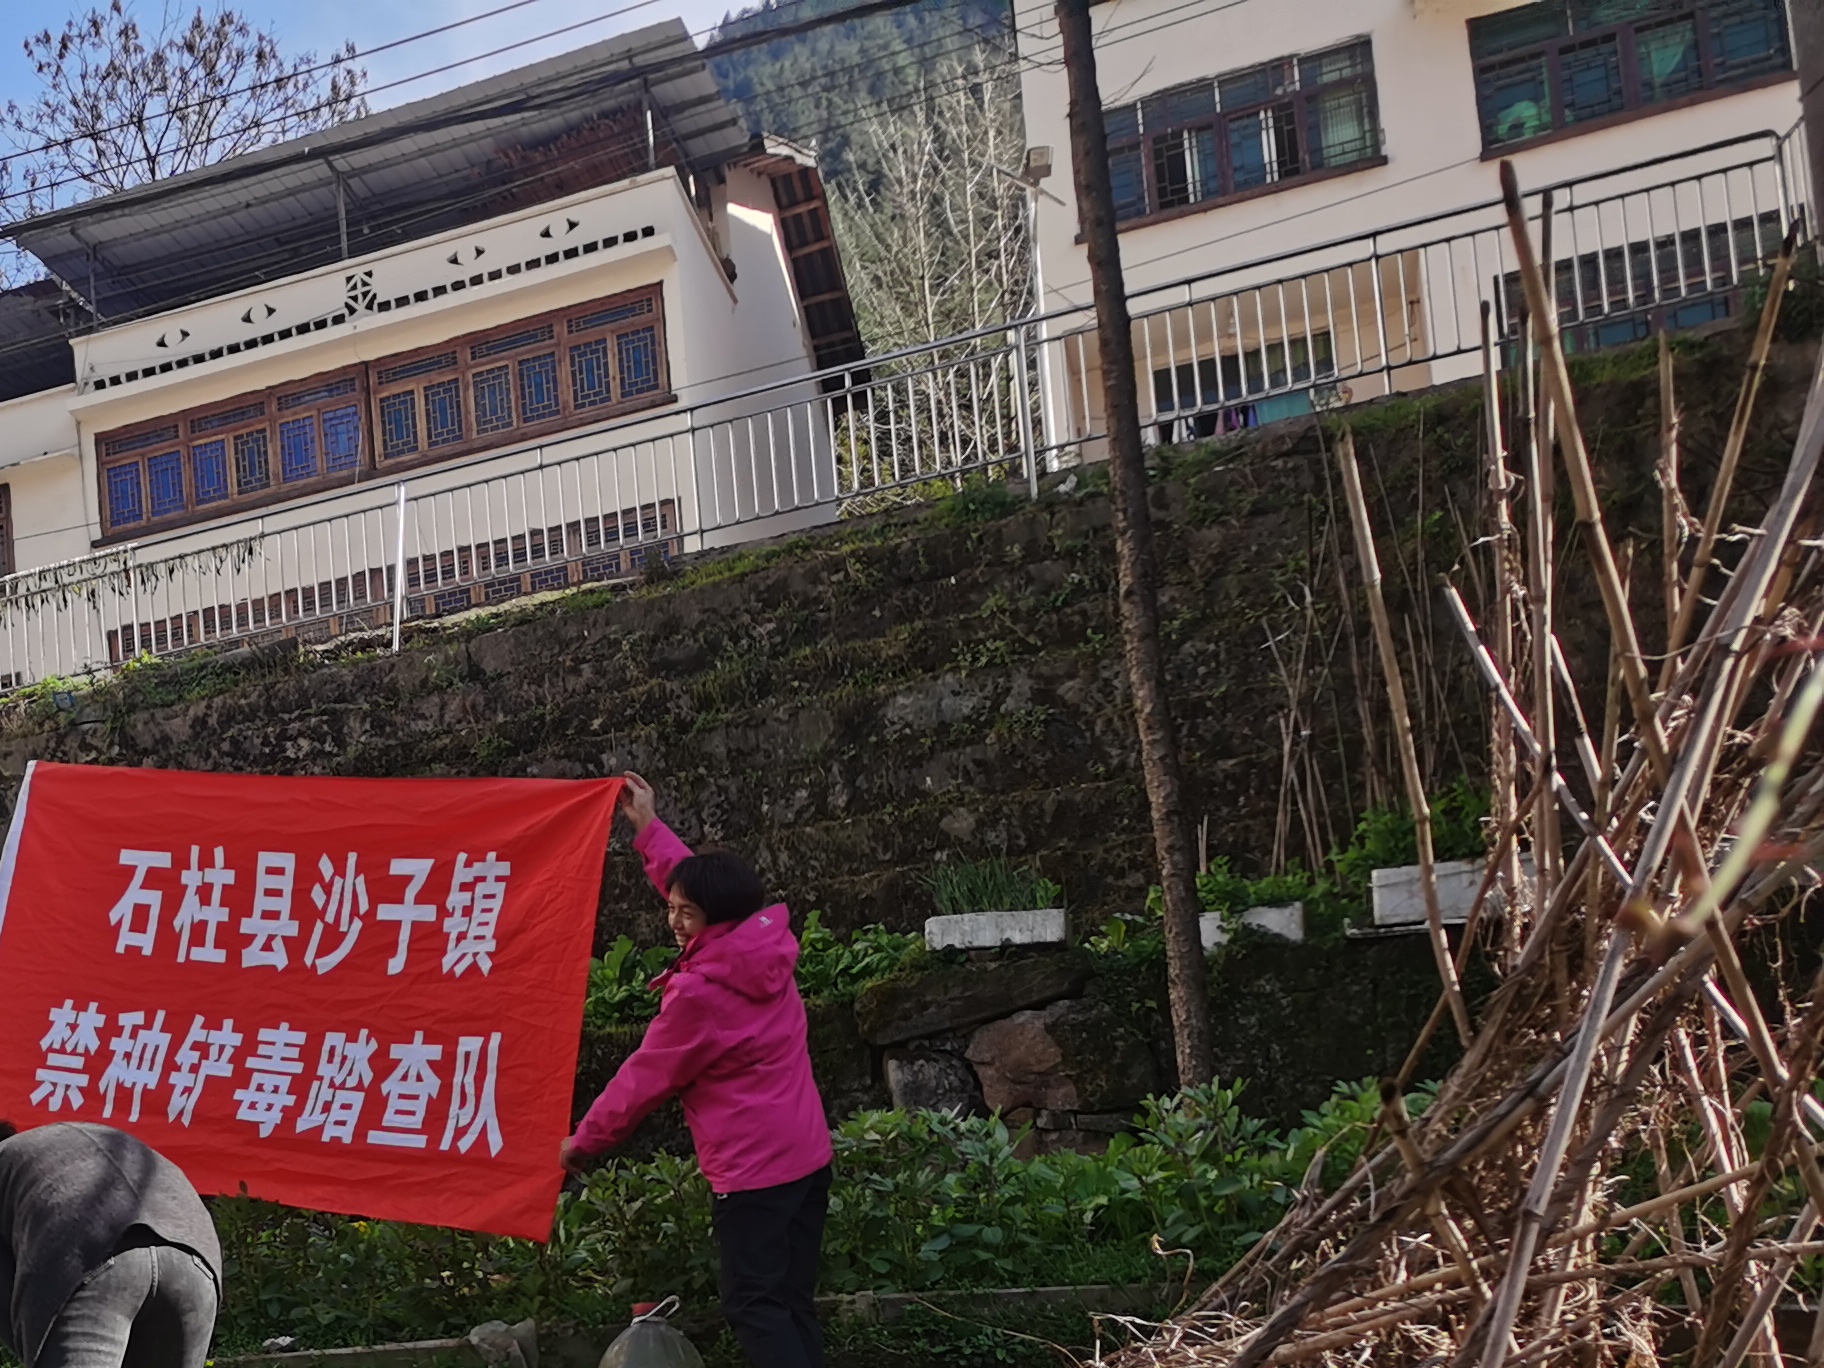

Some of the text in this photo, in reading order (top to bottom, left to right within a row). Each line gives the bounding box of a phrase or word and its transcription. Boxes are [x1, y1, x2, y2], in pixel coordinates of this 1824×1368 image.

[109, 845, 511, 977] 石柱县沙子镇
[30, 999, 503, 1158] 禁种铲毒踏查队
